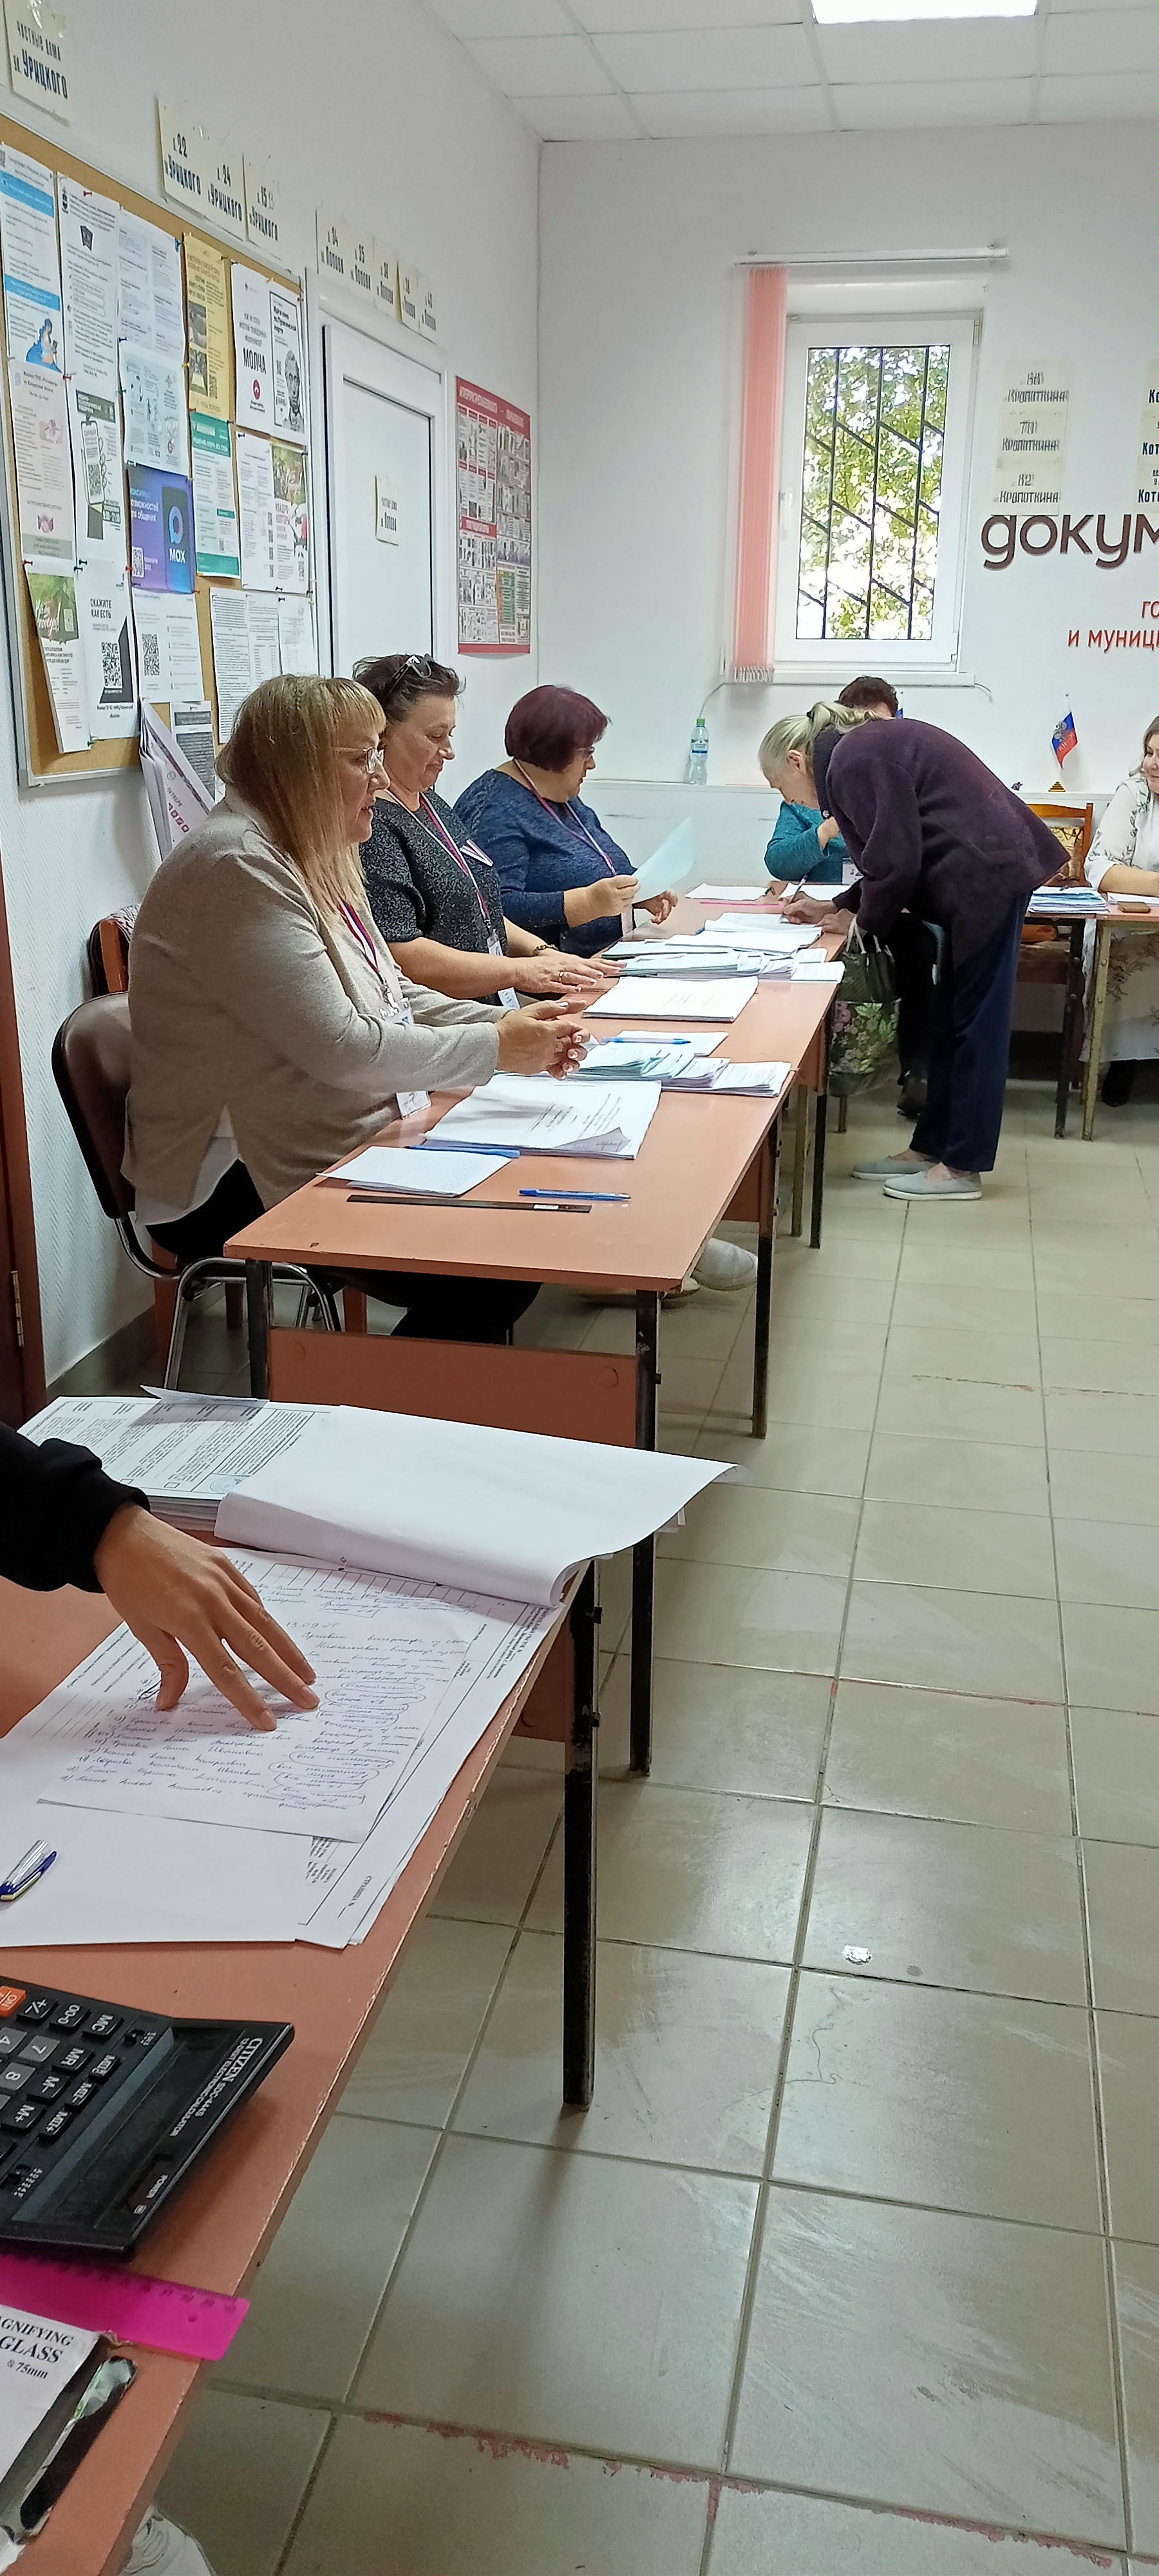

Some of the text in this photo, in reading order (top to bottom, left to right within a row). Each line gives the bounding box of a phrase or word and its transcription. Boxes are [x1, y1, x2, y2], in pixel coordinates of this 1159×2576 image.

[243, 348, 266, 374] МОЛЧА
[90, 598, 111, 609] СКАЖИТЕ
[91, 609, 111, 619] КАК ЕСТЬ
[1068, 630, 1079, 647] и
[92, 2014, 113, 2032] MC
[32, 2045, 47, 2054] 7
[61, 2047, 84, 2066] MR
[222, 2038, 263, 2082] CITIZEN
[6, 2071, 21, 2081] 8
[0, 2317, 74, 2347] GNIFYING
[0, 2335, 63, 2363] GLASS
[18, 2362, 48, 2379] 75mm
